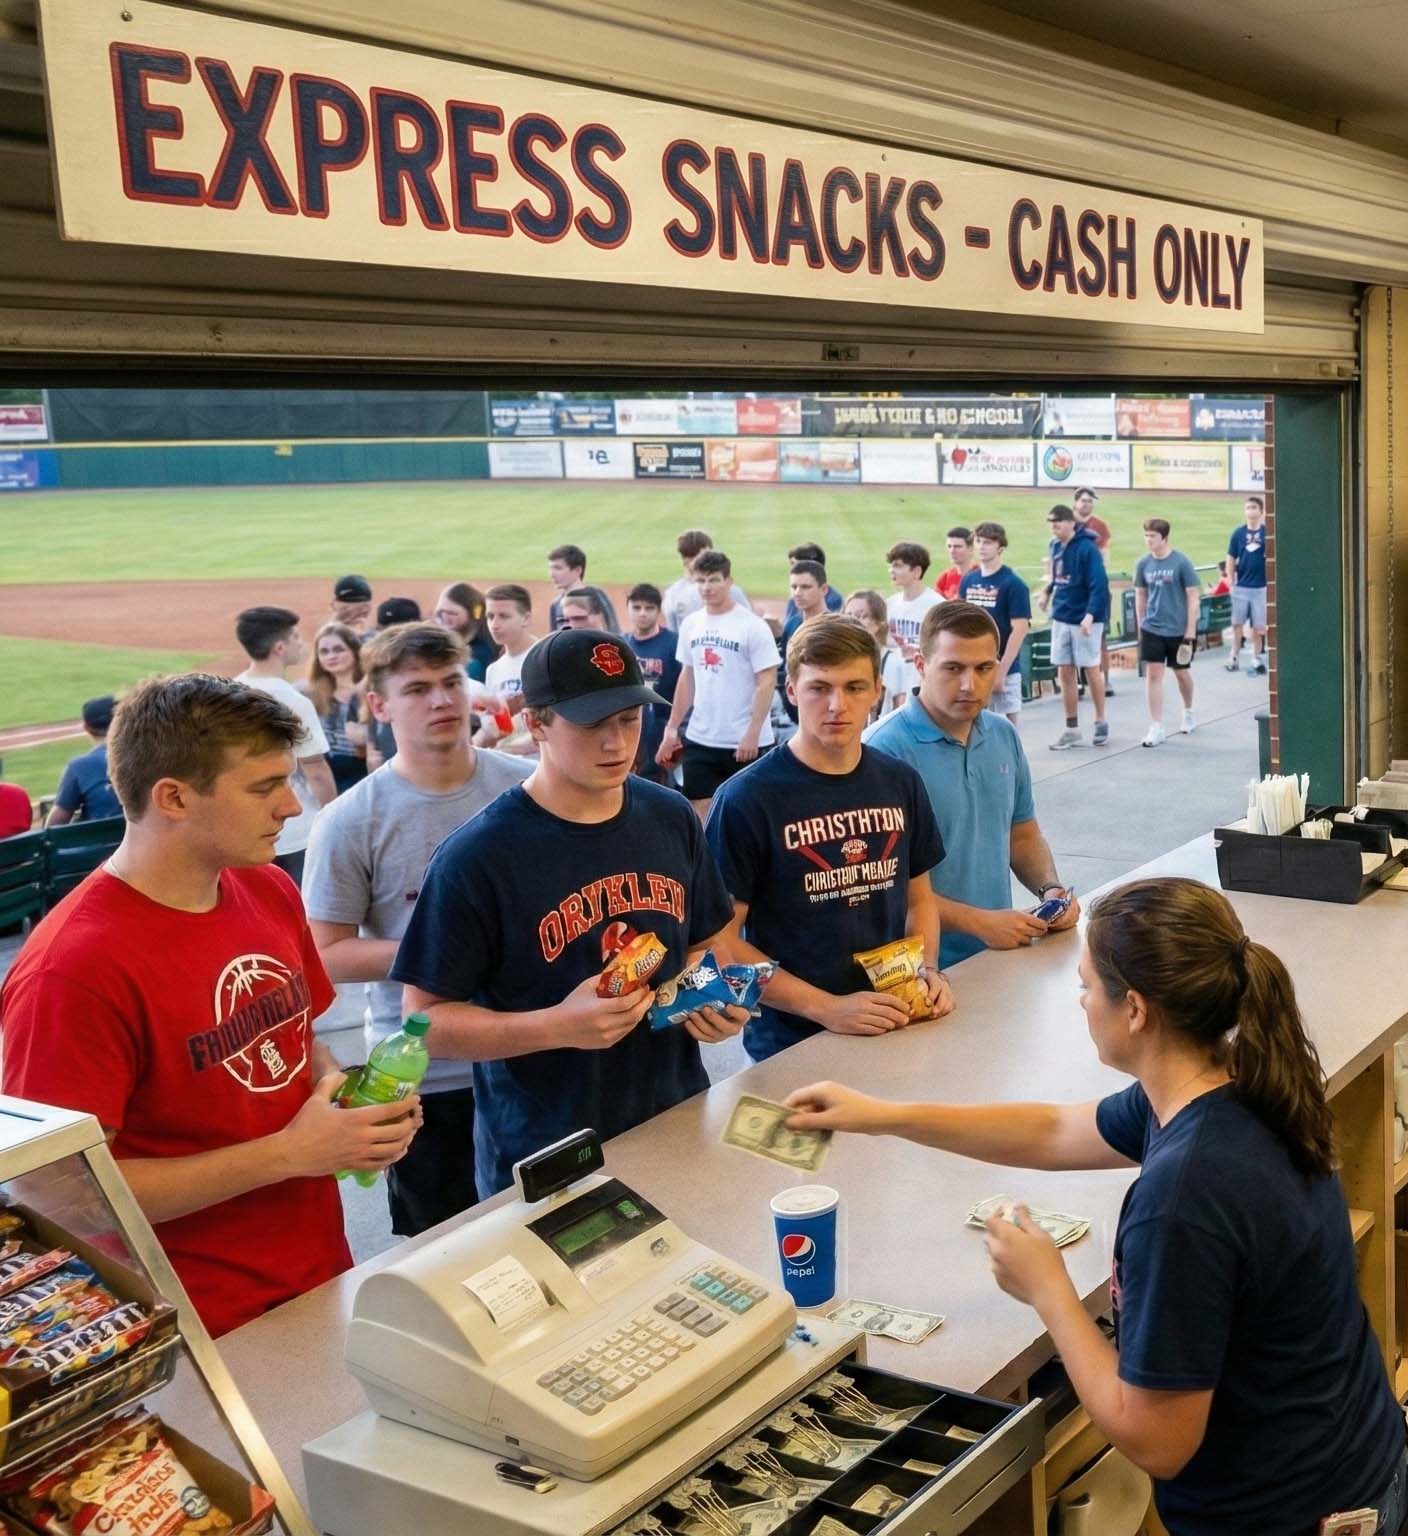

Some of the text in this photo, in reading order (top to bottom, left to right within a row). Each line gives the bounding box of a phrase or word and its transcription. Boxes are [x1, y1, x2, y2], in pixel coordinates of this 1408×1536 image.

[109, 42, 1251, 310] EXPRESS SNACKS - CASH ONLY
[786, 1265, 816, 1278] pepsi
